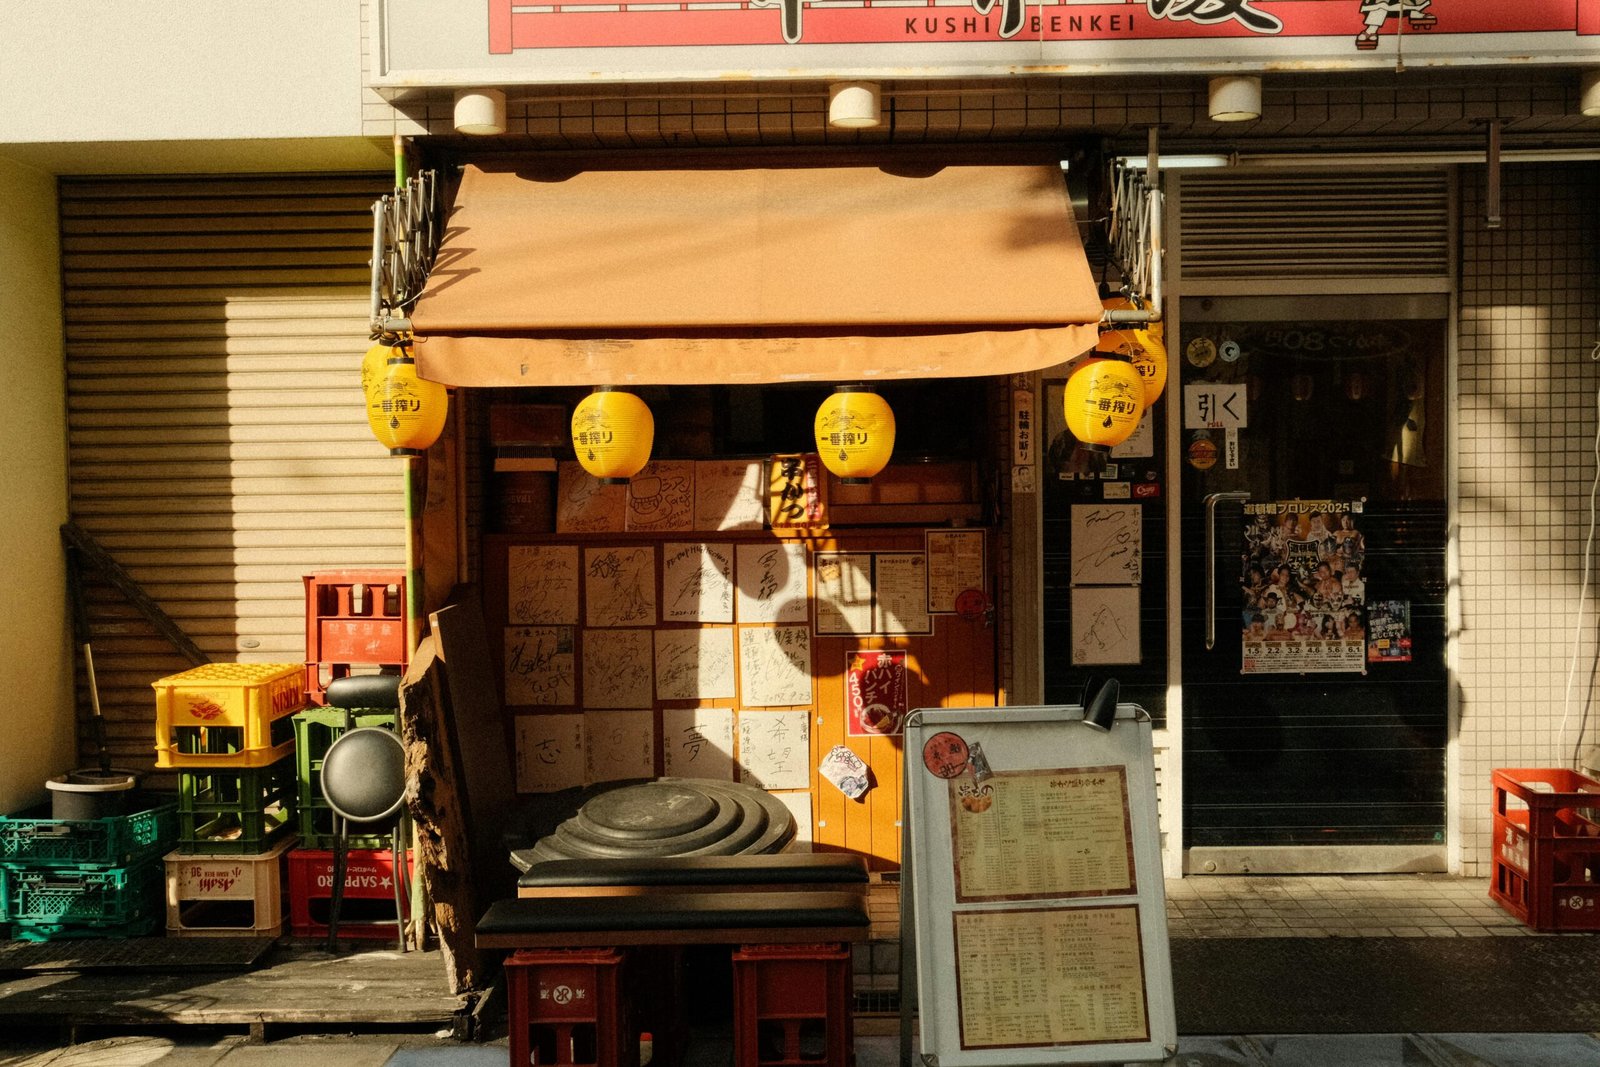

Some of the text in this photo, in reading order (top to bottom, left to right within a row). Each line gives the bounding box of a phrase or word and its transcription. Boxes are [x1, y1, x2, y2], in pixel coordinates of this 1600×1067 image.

[905, 16, 991, 34] KUSHI
[1030, 15, 1135, 33] BENKEI
[371, 398, 421, 413] 一番搾り
[1084, 397, 1136, 416] 一番搾り
[1197, 391, 1240, 422] 引く
[573, 430, 613, 446] 一番搾り
[820, 432, 868, 447] 一番搾り
[1018, 410, 1030, 461] 駐輪お断り
[781, 458, 805, 519] 串かつ
[1243, 502, 1350, 515] 道頓堀プロレス2025
[876, 653, 893, 694] 赤ハイ
[864, 669, 878, 704] パンチ
[272, 687, 299, 715] KIRIN
[535, 739, 561, 764] 志
[682, 724, 709, 762] 夢
[767, 715, 793, 775] 希望
[191, 867, 202, 878] 30
[232, 867, 242, 878] 小
[317, 875, 378, 888] SAPPRO
[198, 878, 235, 892] Asahi
